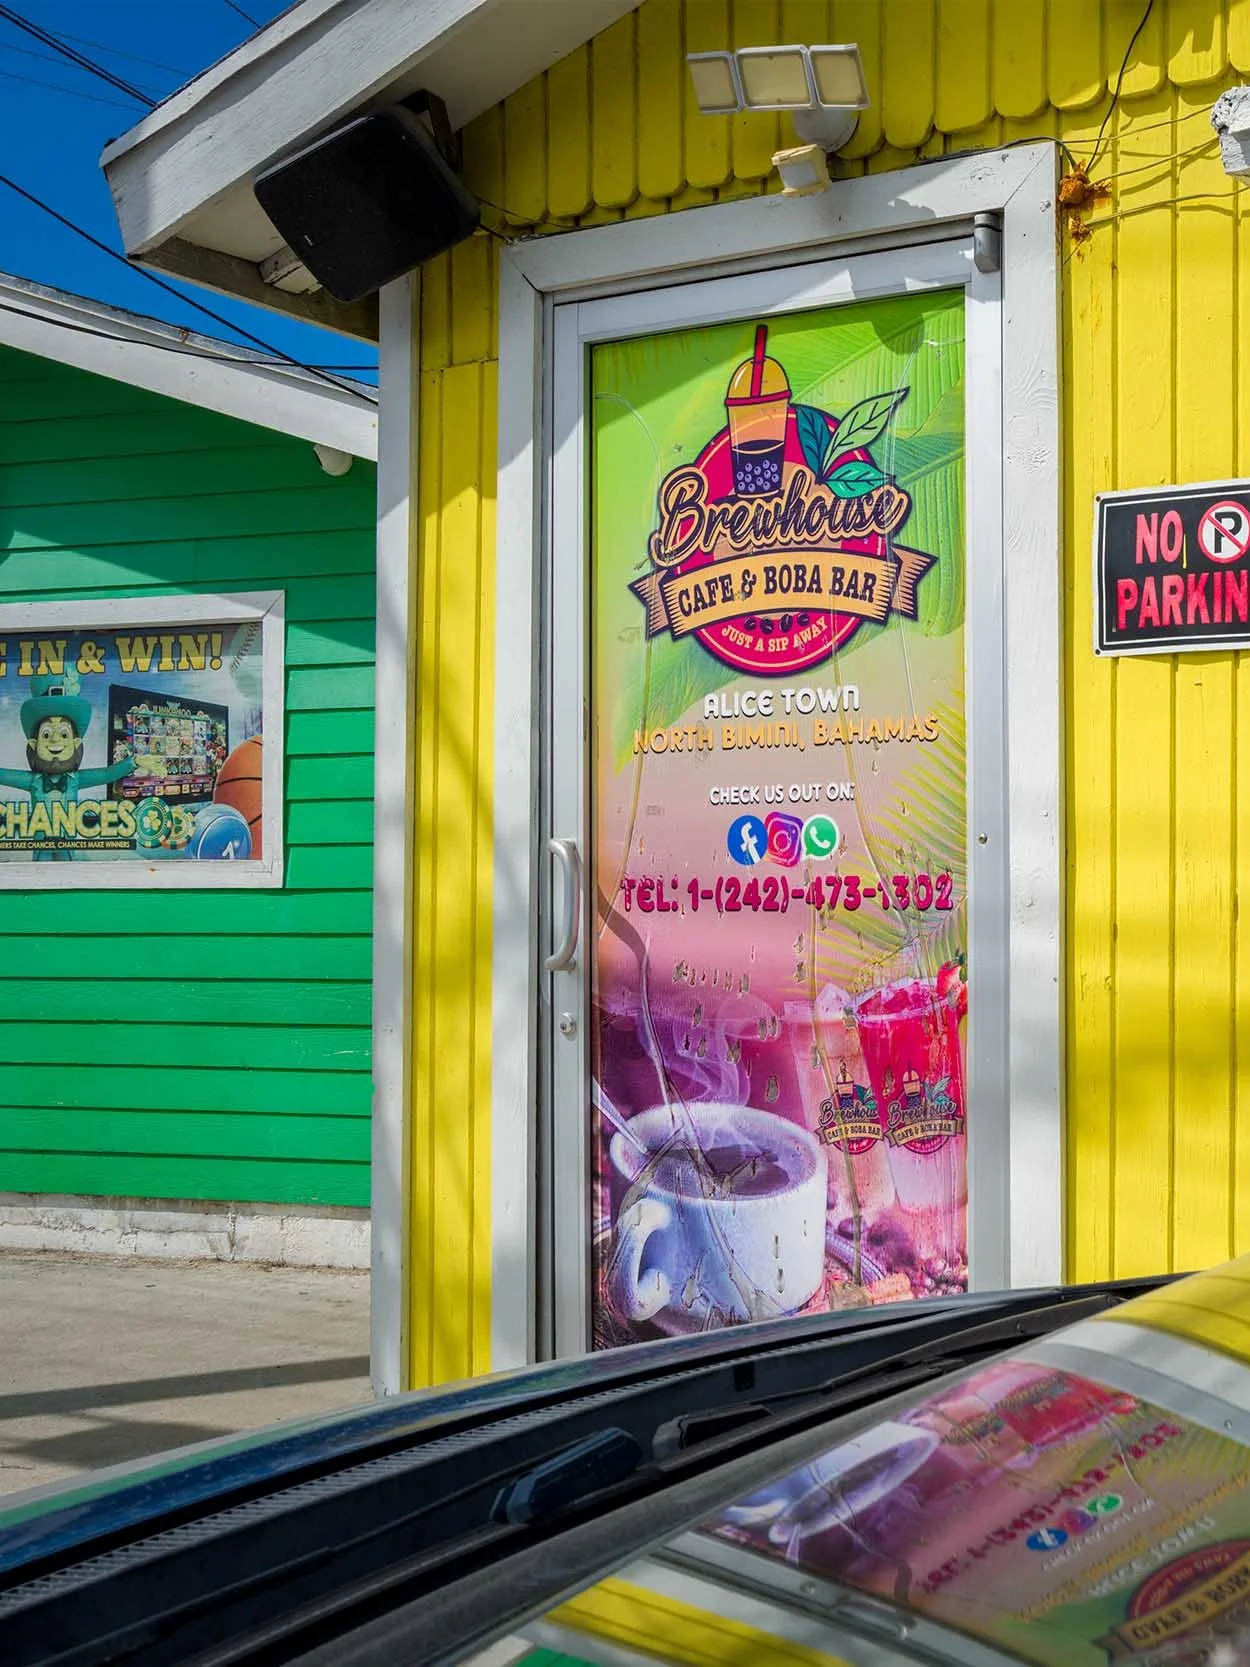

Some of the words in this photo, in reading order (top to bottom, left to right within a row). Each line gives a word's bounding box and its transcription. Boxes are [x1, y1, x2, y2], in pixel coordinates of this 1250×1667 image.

[654, 466, 908, 565] Brewhouse
[1135, 510, 1184, 564] NO
[678, 573, 734, 617] CAFE
[742, 568, 757, 598] &
[763, 564, 823, 595] BOBA
[829, 565, 877, 603] BAR
[17, 640, 68, 677] IN
[76, 640, 105, 675] &
[115, 632, 223, 673] WIN!
[721, 624, 753, 650] JUST
[755, 638, 764, 652] A
[768, 636, 789, 652] SIP
[793, 616, 828, 649] AWAY
[703, 689, 774, 719] ALICE
[780, 684, 860, 716] TOWN
[633, 725, 713, 755] NORTH
[721, 721, 806, 753] BIMINI,
[813, 715, 940, 747] BAHAMAS
[709, 783, 760, 805] CHECK
[764, 784, 784, 804] US
[788, 782, 821, 803] OUT
[827, 782, 856, 802] ON:
[621, 875, 680, 914] TEL:
[687, 869, 954, 914] 1-(242)-473-1302
